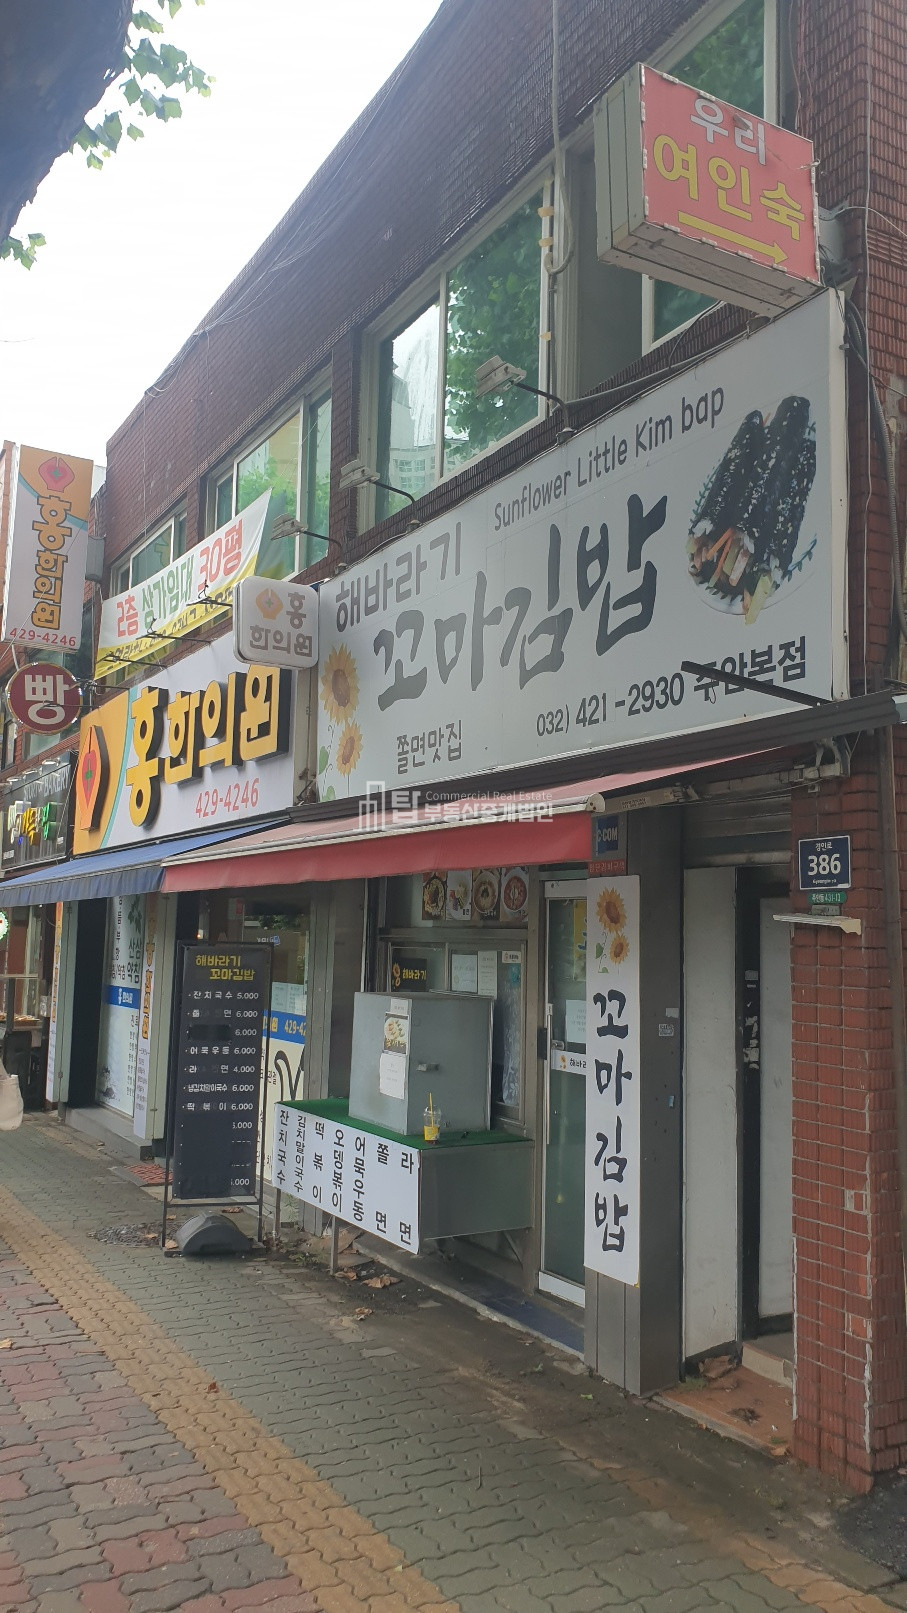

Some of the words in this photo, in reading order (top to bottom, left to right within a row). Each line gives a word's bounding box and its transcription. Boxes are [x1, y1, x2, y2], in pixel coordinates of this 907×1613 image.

[691, 98, 766, 166] 우리
[653, 135, 805, 241] 여인숙
[494, 469, 571, 531] Sunflower
[577, 435, 627, 488] Little
[636, 414, 673, 457] Kim
[681, 387, 724, 434] bap
[31, 494, 73, 630] 홍한의원
[116, 594, 139, 637] 2층
[141, 554, 194, 629] 상가임대
[198, 518, 243, 592] 30평
[335, 522, 463, 632] 해바라기
[286, 592, 307, 630] 홍
[373, 493, 667, 712] 꼬마김밥
[9, 627, 77, 647] 429-4246
[249, 624, 313, 657] 한의원
[24, 674, 72, 726] 빵
[536, 704, 570, 736] 032)
[126, 664, 285, 828] 홍한의원
[396, 720, 463, 775] 쫄면맛집
[195, 777, 260, 819] 429-4246
[808, 853, 841, 876] 386
[815, 842, 833, 852] 경인로
[195, 954, 242, 967] 해바라기
[209, 968, 256, 981] 꼬마김밥
[402, 968, 427, 980] 해바라기
[277, 1109, 290, 1185] 잔치국수
[294, 1114, 307, 1192] 김치말이국수
[592, 988, 633, 1253] 꼬마김밥
[332, 1129, 345, 1213] 오뎅볶이
[353, 1136, 366, 1222] 어묵우동
